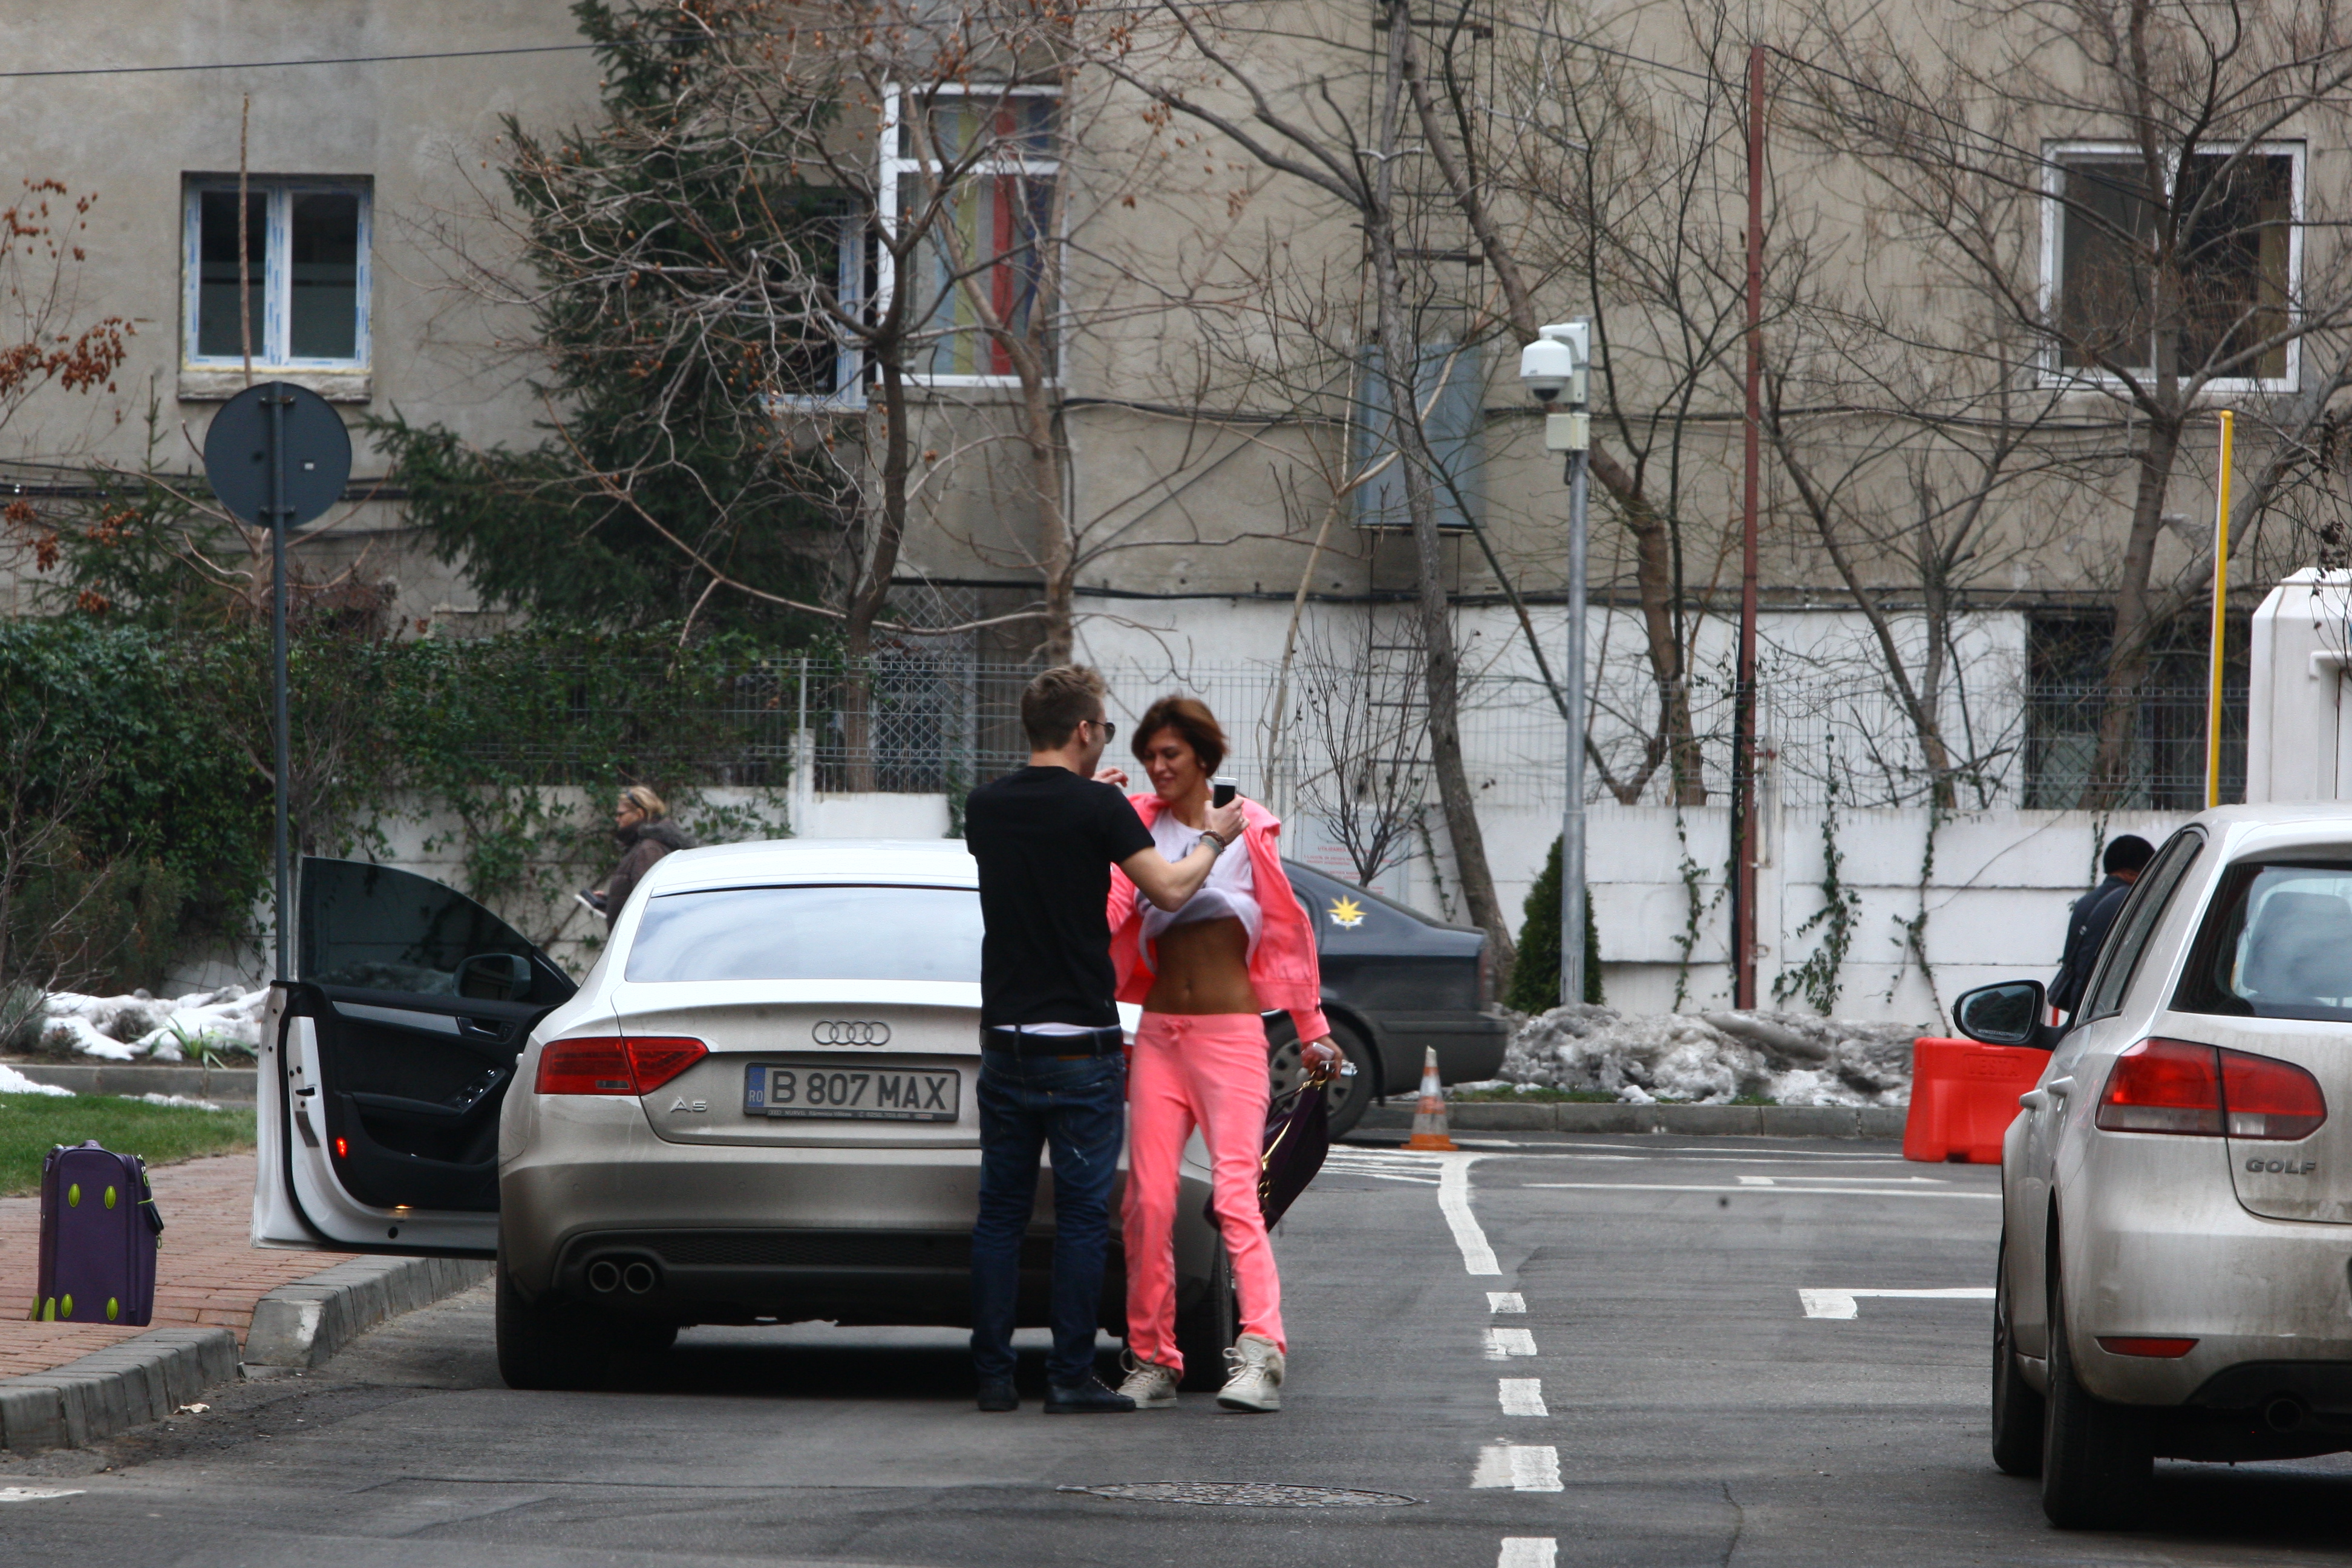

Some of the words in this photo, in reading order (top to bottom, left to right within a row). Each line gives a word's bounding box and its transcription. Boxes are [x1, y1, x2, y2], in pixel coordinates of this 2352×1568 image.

[748, 1090, 763, 1103] RO
[771, 1071, 797, 1103] B
[806, 1073, 870, 1106] 807
[878, 1075, 948, 1110] MAX
[670, 1096, 707, 1113] A5
[2246, 1156, 2316, 1175] GOLF
